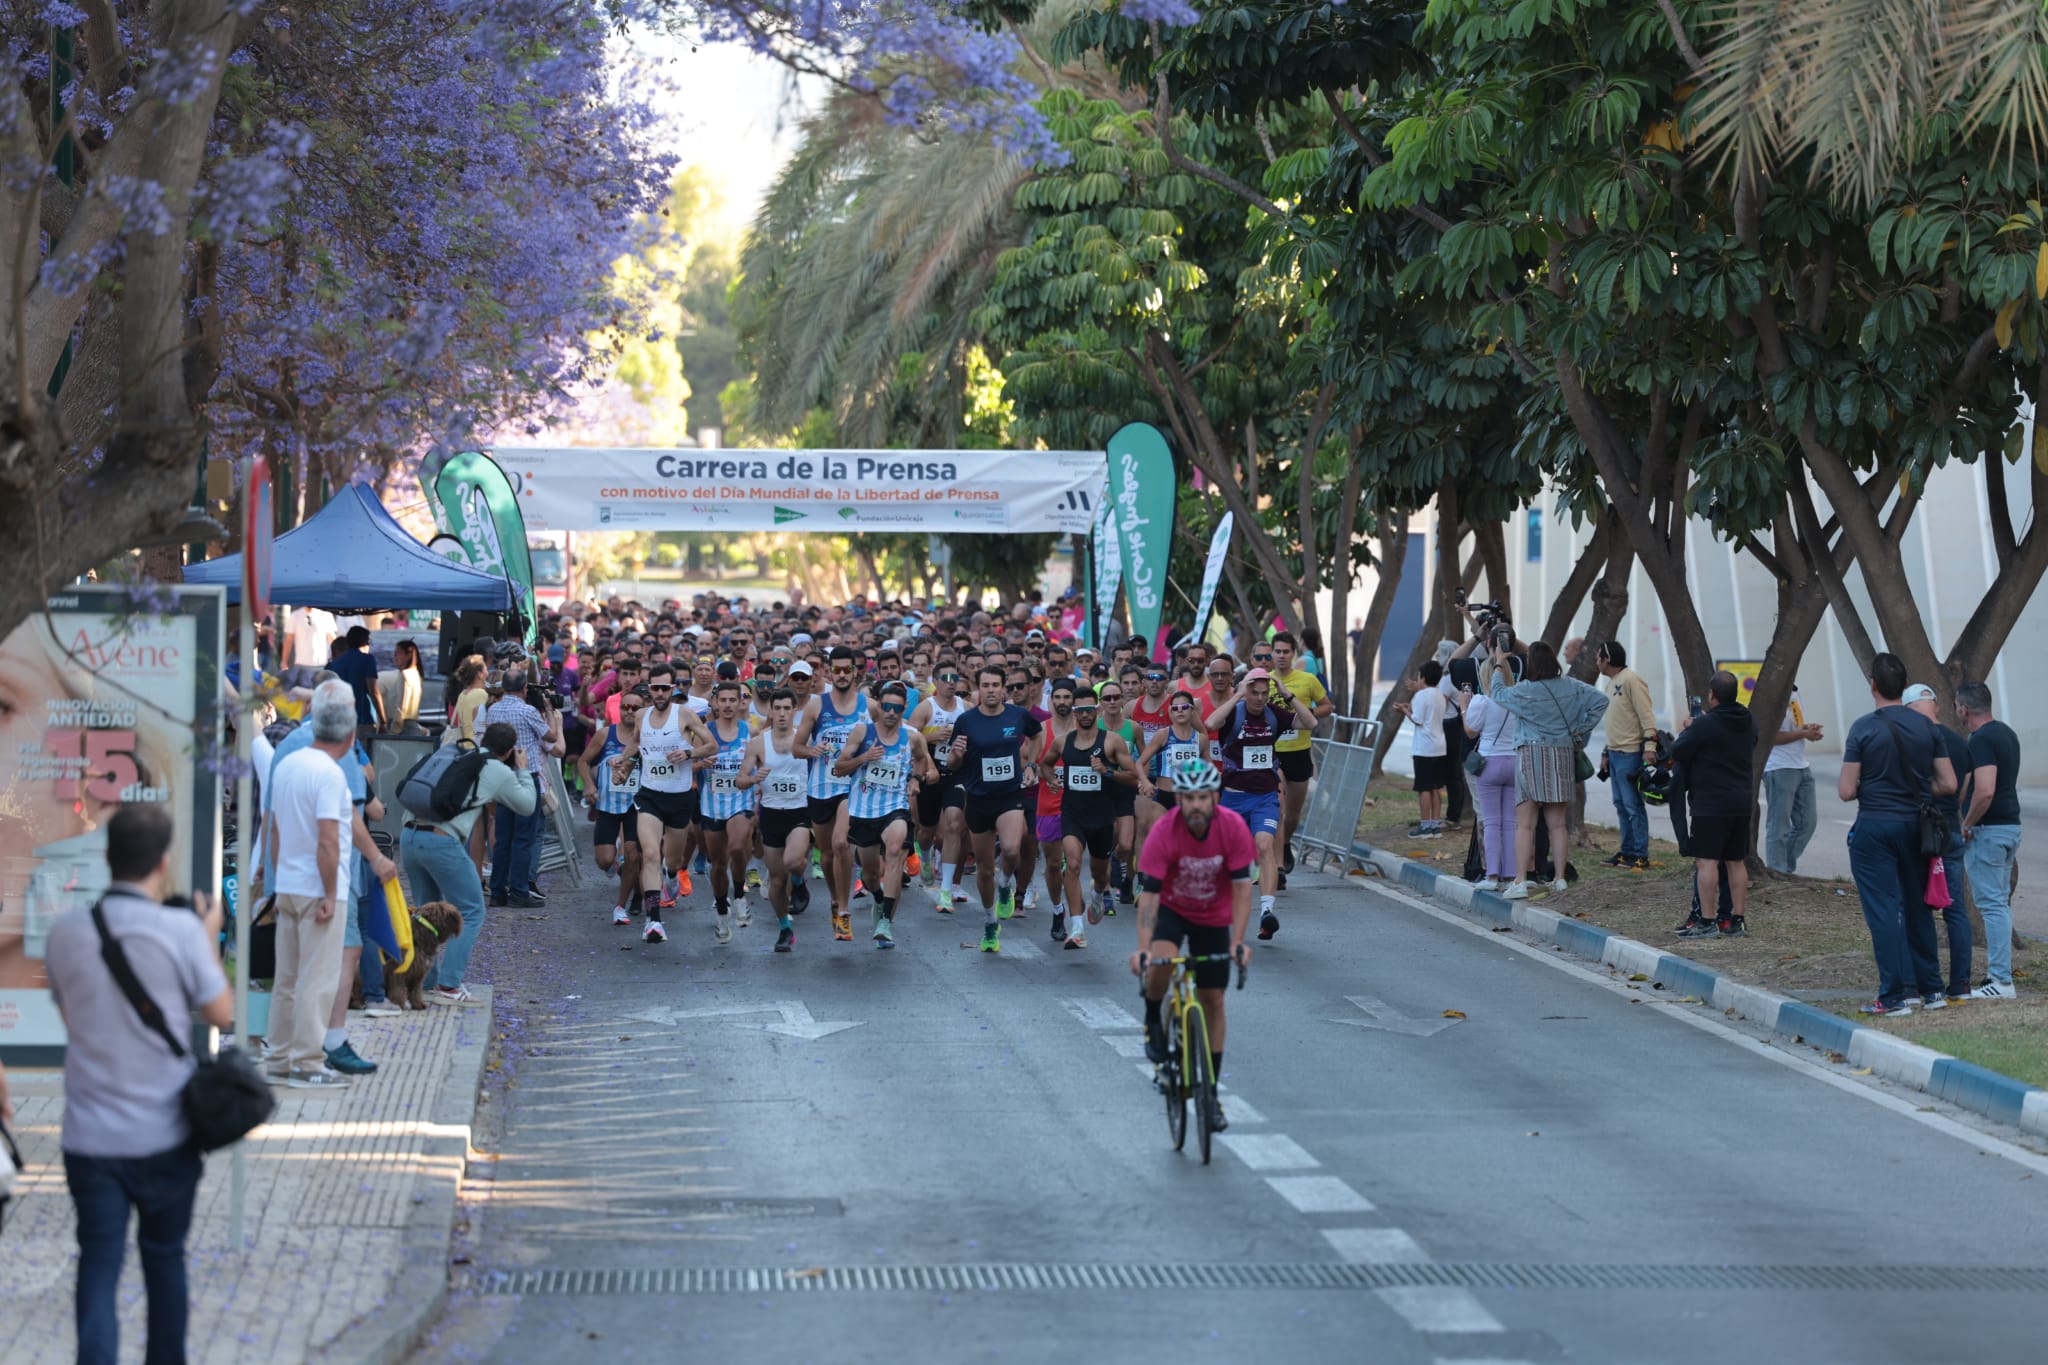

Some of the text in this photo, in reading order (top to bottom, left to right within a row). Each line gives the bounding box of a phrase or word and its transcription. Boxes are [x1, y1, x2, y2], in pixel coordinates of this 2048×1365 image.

[656, 455, 957, 481] Carrera de la Prensa
[600, 486, 1000, 501] con motivo del Día Mundial de la Libertad de Prensa
[47, 711, 137, 728] ANTIEDAD
[1175, 751, 1197, 760] 665
[1251, 753, 1267, 763] 28
[47, 730, 140, 801] 15
[650, 765, 675, 776] 401
[986, 764, 1011, 776] 199
[870, 767, 896, 780] 471
[1072, 774, 1098, 785] 668
[772, 782, 797, 793] 136
